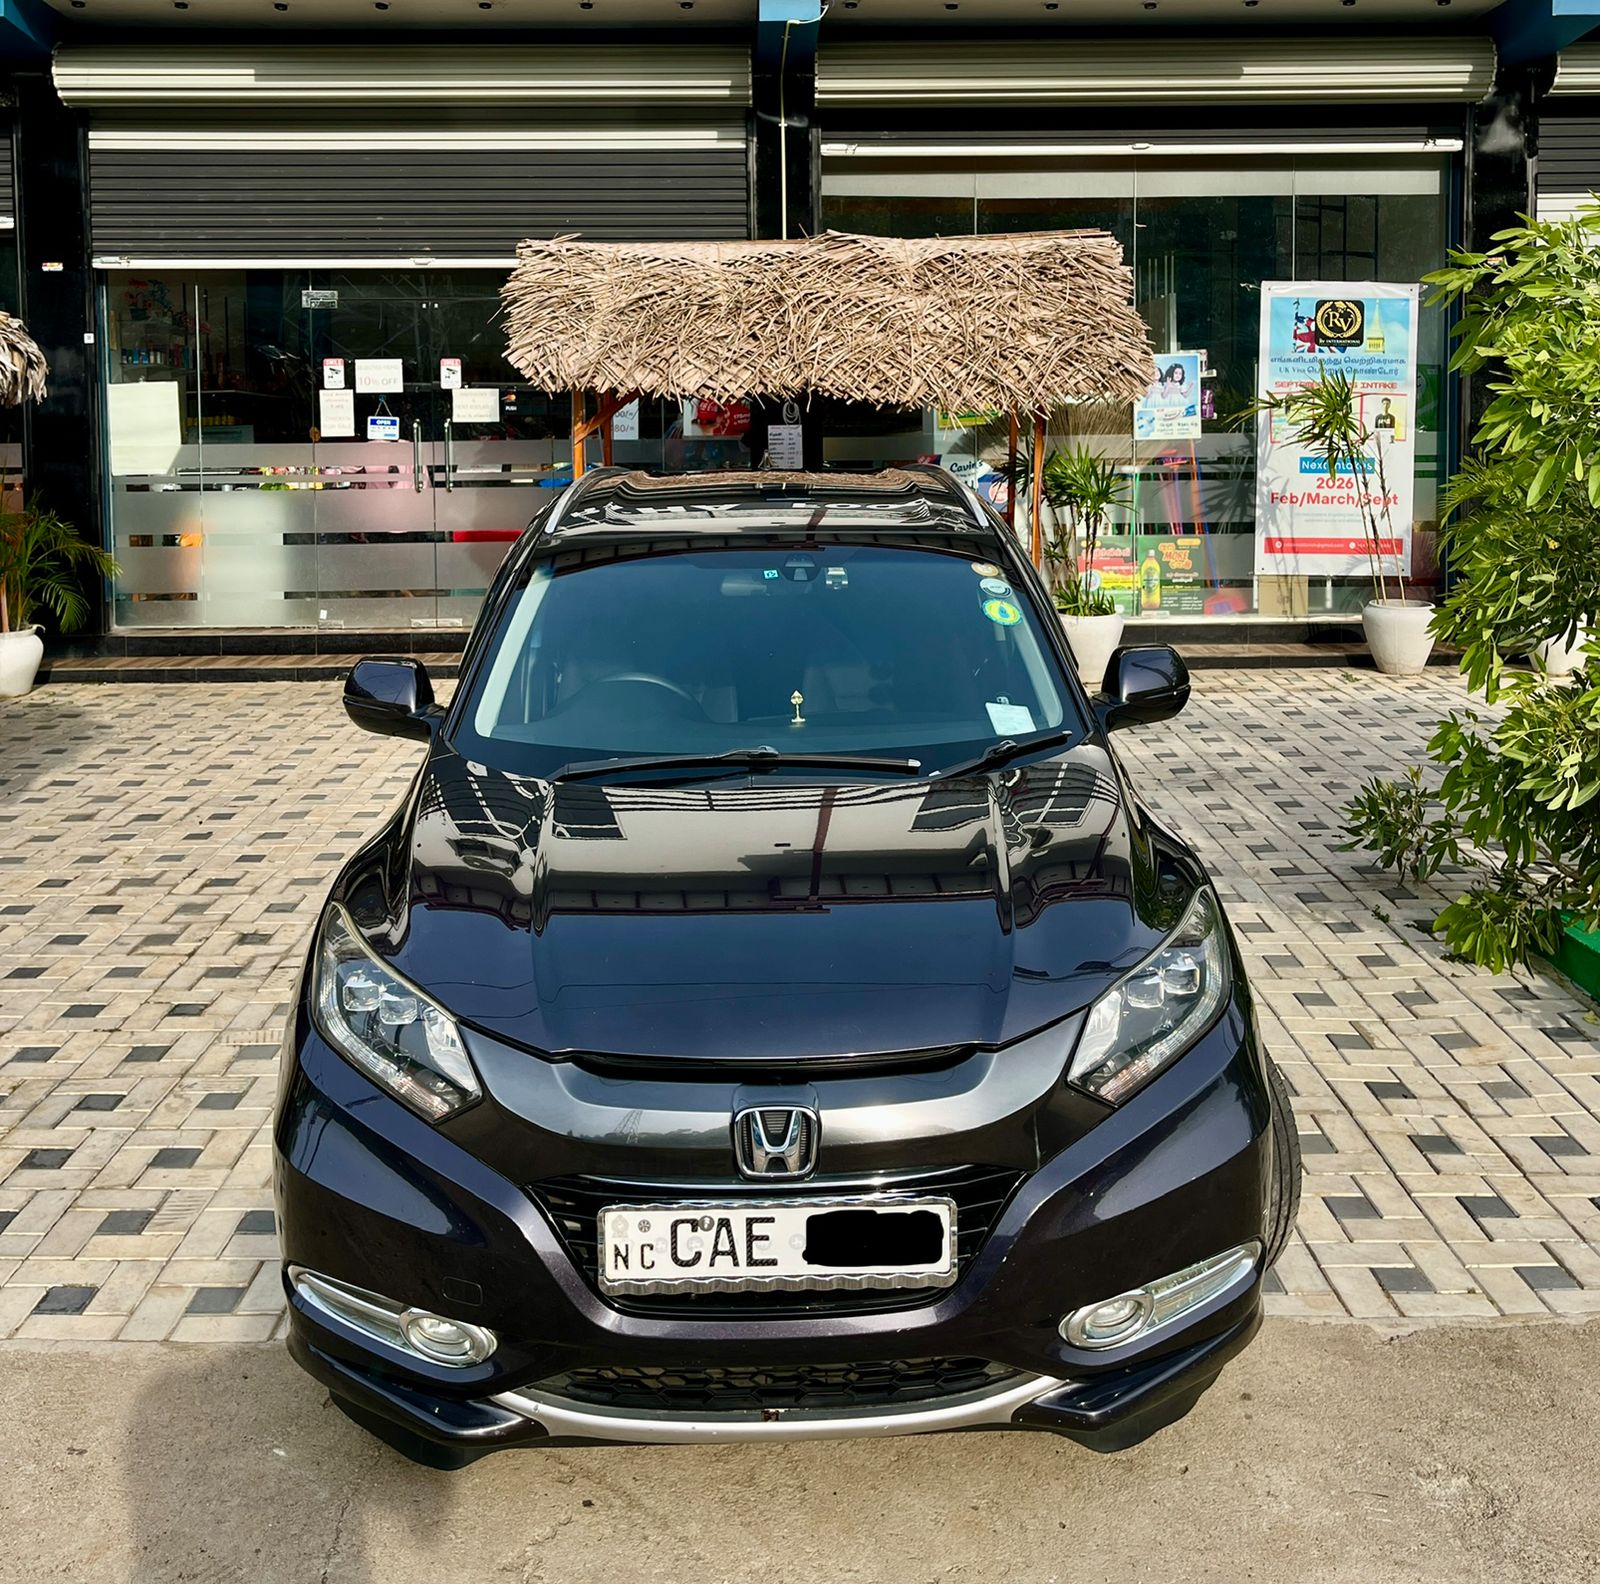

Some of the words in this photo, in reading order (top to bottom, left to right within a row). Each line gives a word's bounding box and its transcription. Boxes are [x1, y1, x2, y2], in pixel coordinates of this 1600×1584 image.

[1328, 311, 1352, 332] RV
[1316, 477, 1354, 489] 2026
[1270, 492, 1399, 507] Feb/March/Sept
[670, 1216, 778, 1268] CAE
